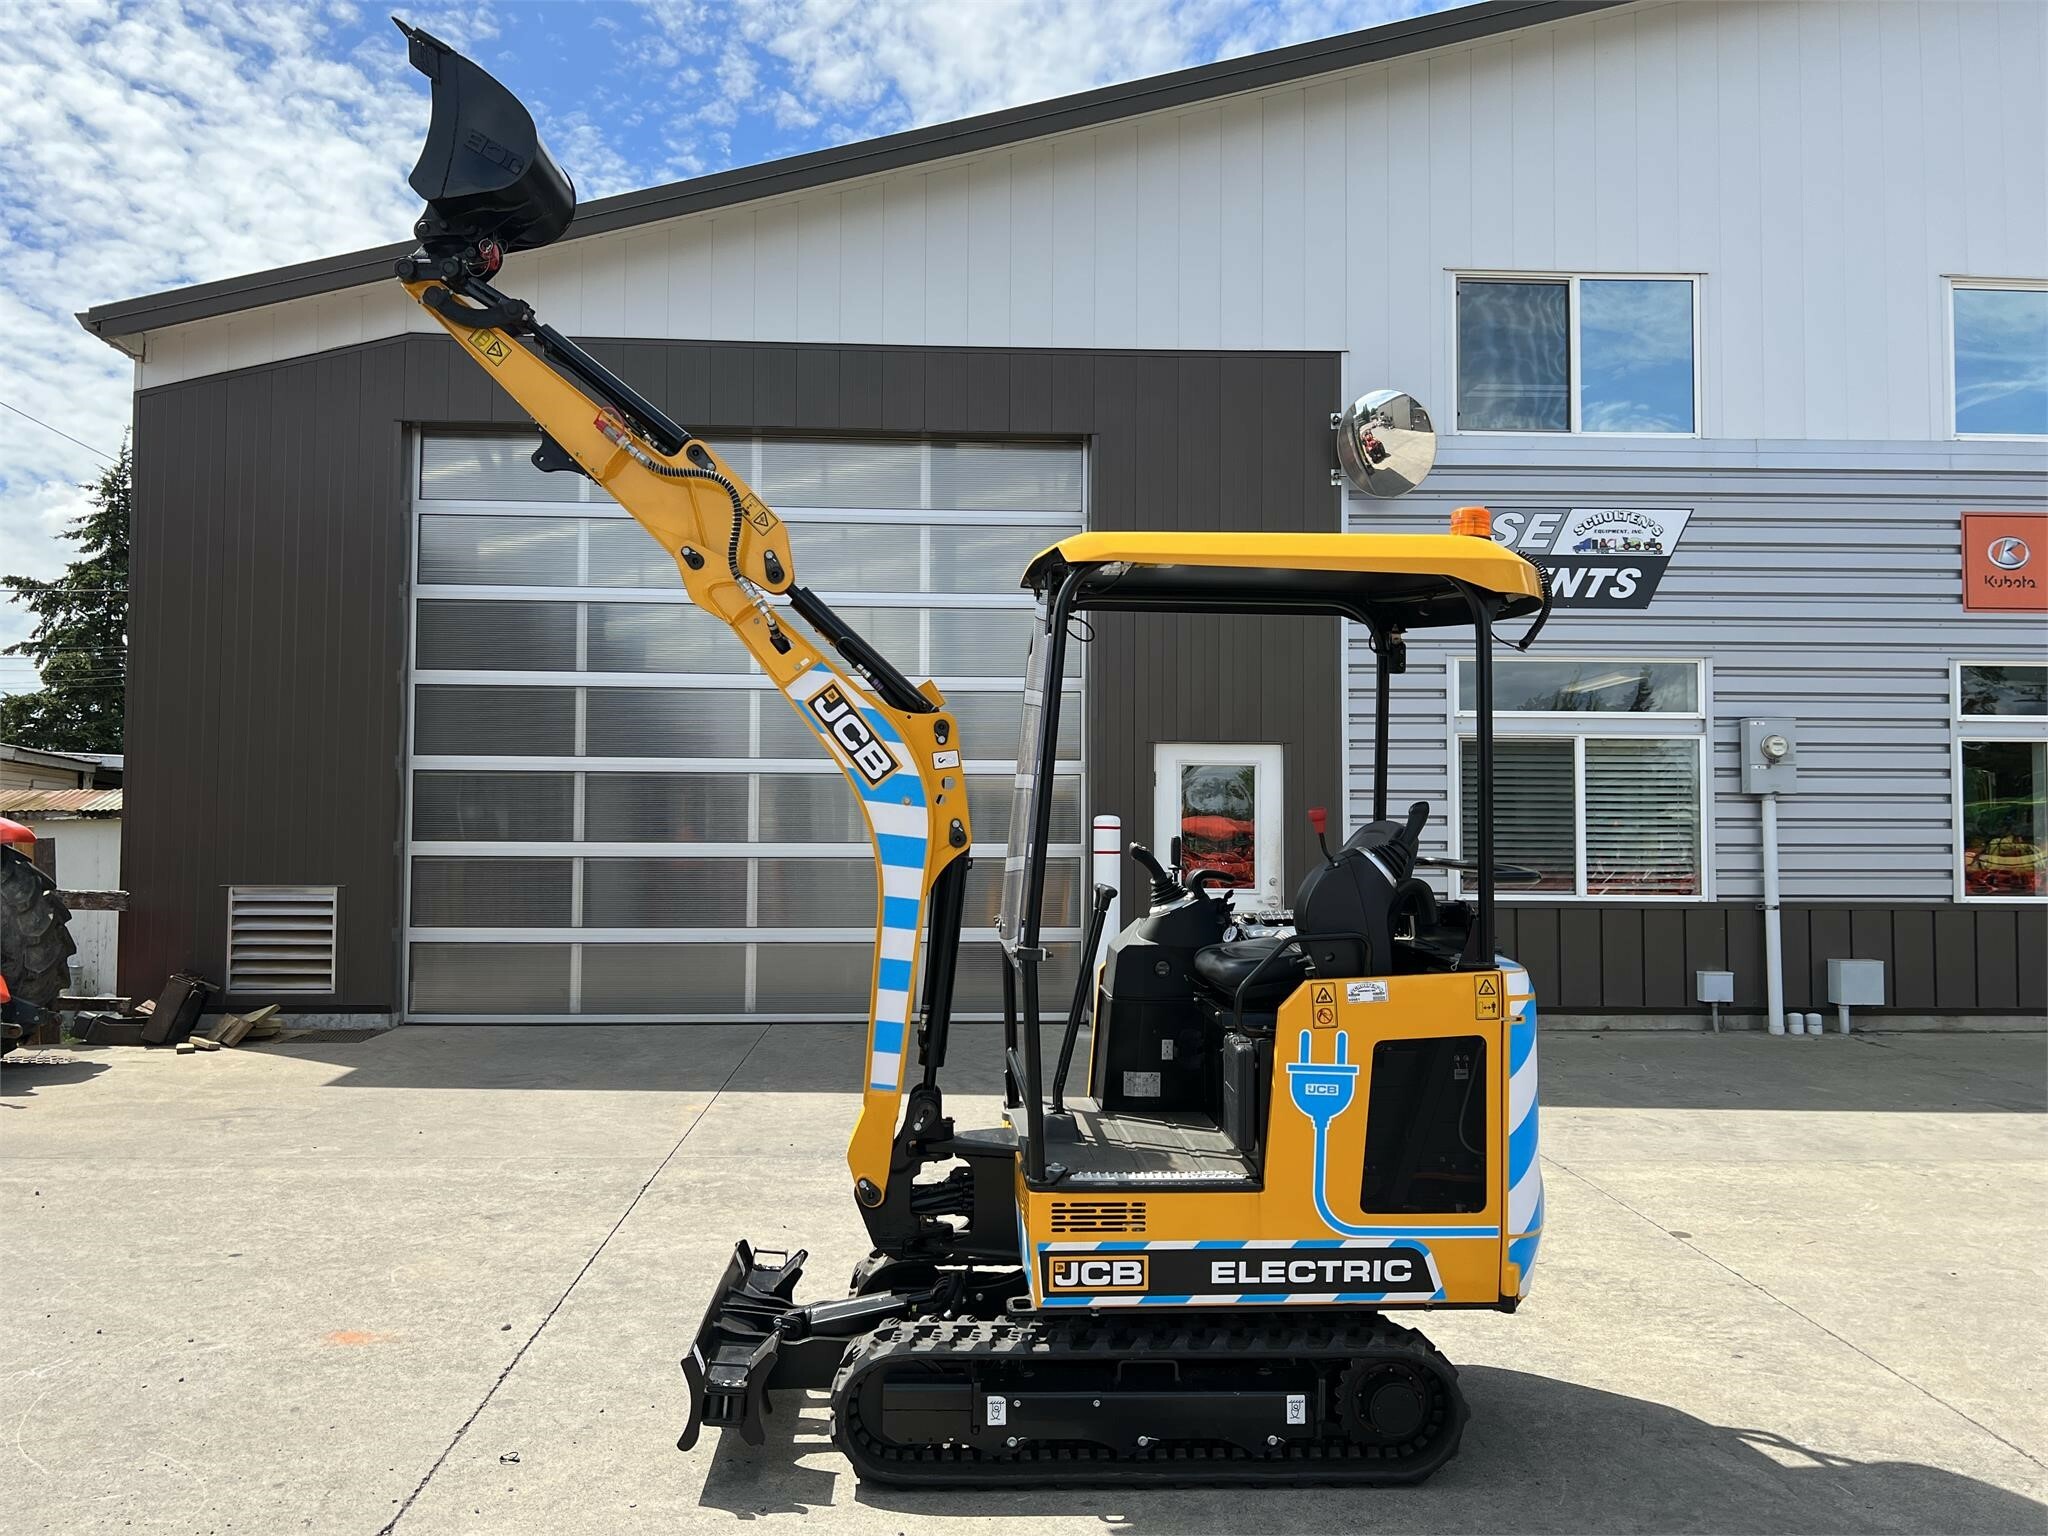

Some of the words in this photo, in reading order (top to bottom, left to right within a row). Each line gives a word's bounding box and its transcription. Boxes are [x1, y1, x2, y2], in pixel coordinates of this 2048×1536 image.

[1573, 510, 1664, 537] SCHOLTEN'S
[1546, 567, 1643, 598] NTS
[1984, 575, 2036, 588] Kubota
[814, 696, 892, 780] JCB
[1307, 1084, 1337, 1094] JCB
[1054, 1261, 1143, 1286] JCB
[1211, 1259, 1412, 1284] ELECTRIC
